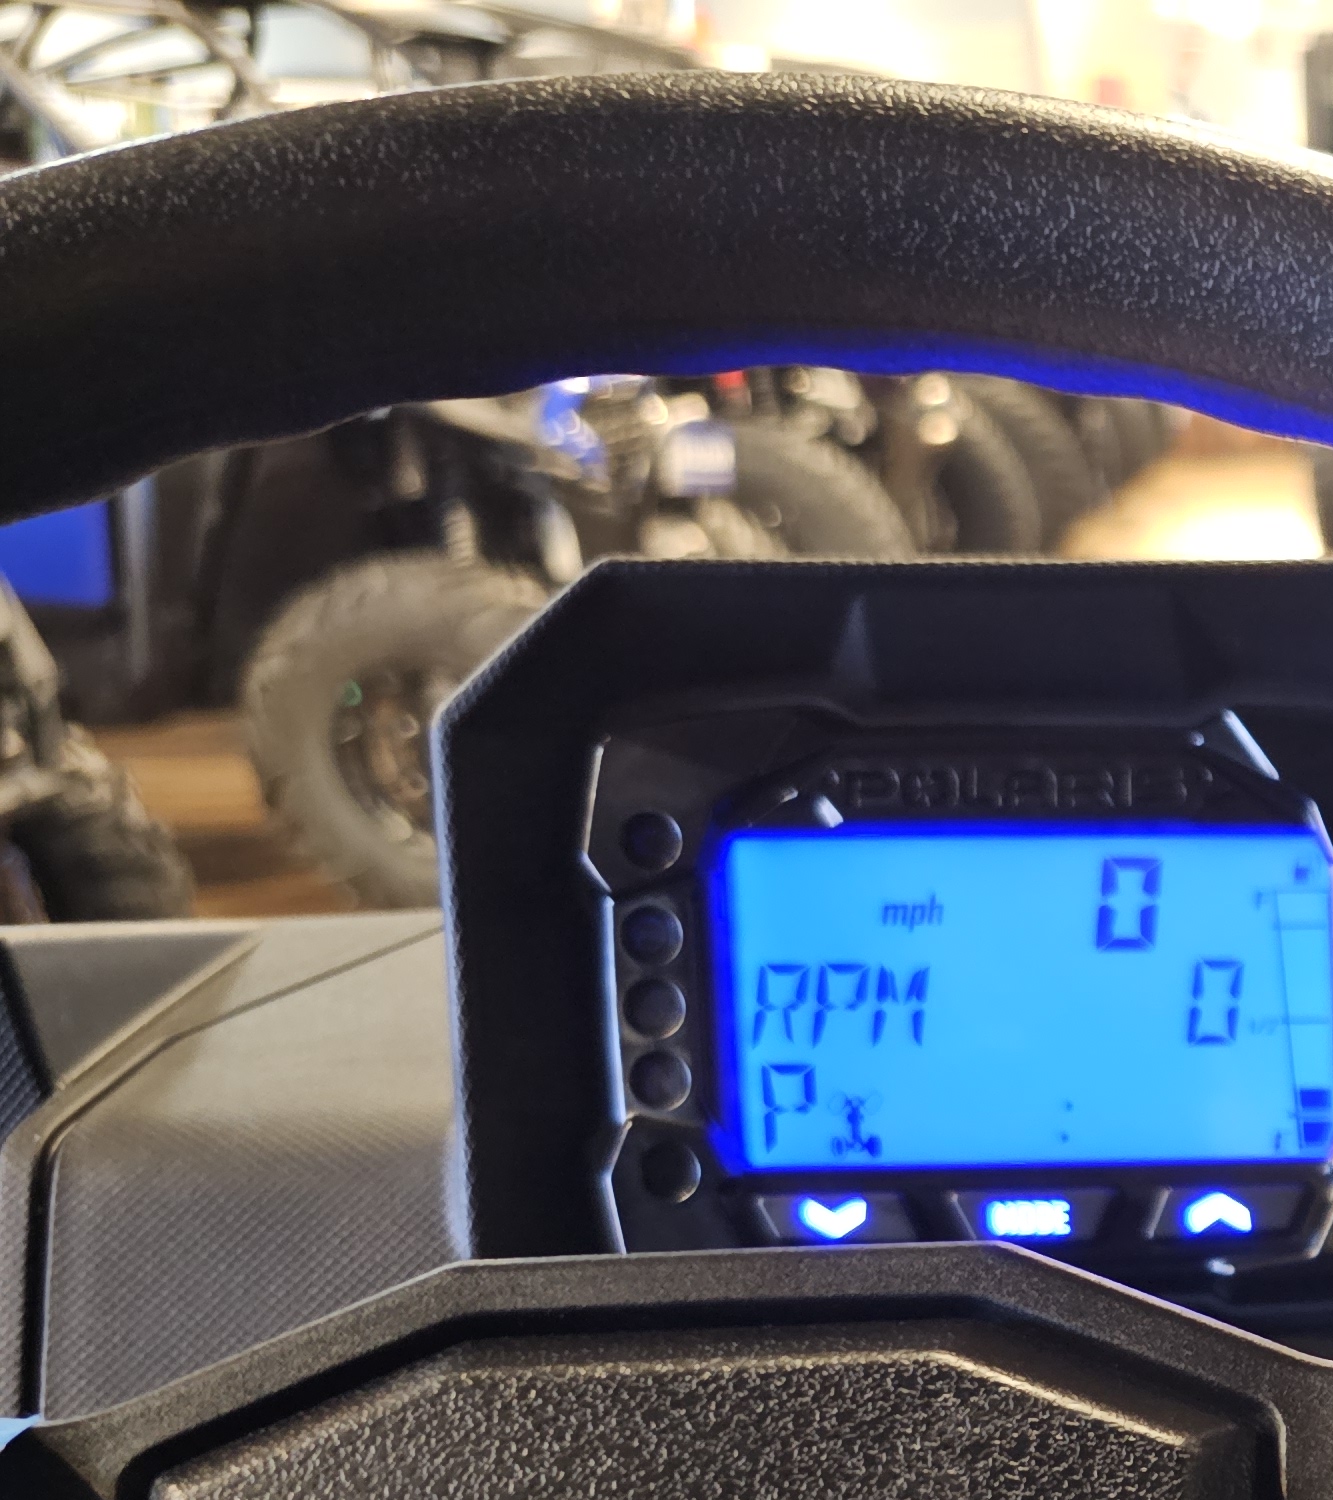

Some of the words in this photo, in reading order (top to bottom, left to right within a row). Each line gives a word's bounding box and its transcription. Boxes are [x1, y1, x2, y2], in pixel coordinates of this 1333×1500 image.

[845, 764, 1190, 808] POLARIS
[881, 891, 943, 929] mph
[1096, 856, 1162, 950] 0
[752, 962, 930, 1047] RPM
[1187, 960, 1244, 1045] 0
[761, 1063, 816, 1152] P
